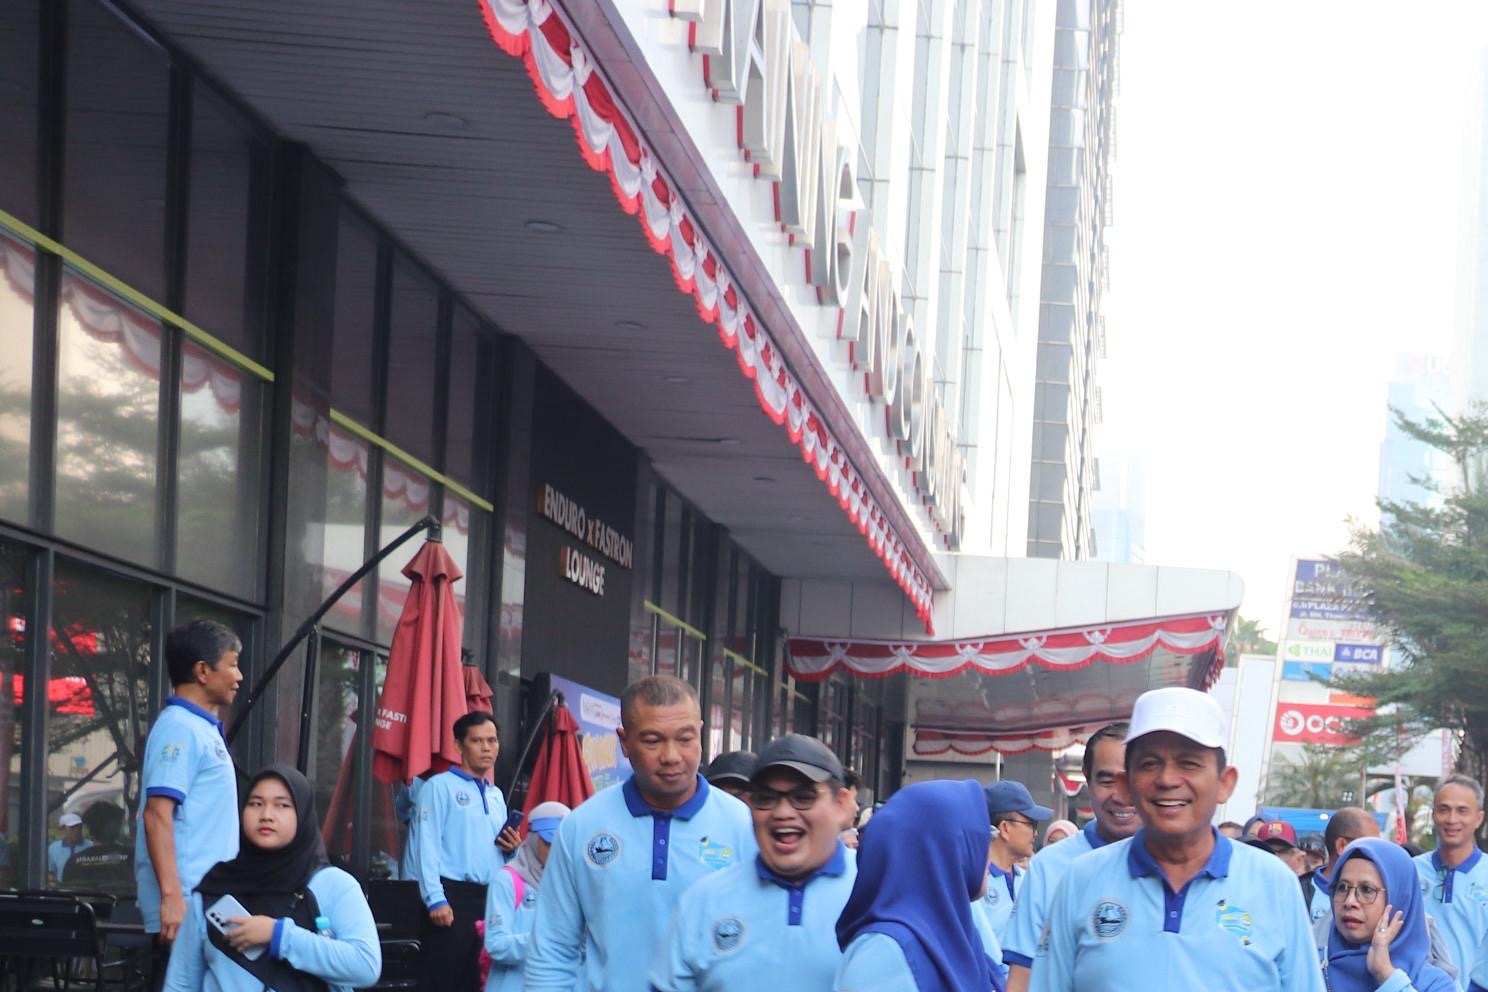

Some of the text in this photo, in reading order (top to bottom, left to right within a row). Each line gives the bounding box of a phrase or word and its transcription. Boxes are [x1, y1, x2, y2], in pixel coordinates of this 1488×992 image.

[544, 482, 586, 541] ENDURO
[594, 518, 633, 570] FASTRON
[565, 545, 606, 597] LOUNGE
[1352, 647, 1378, 660] BCA
[381, 708, 407, 724] FAST
